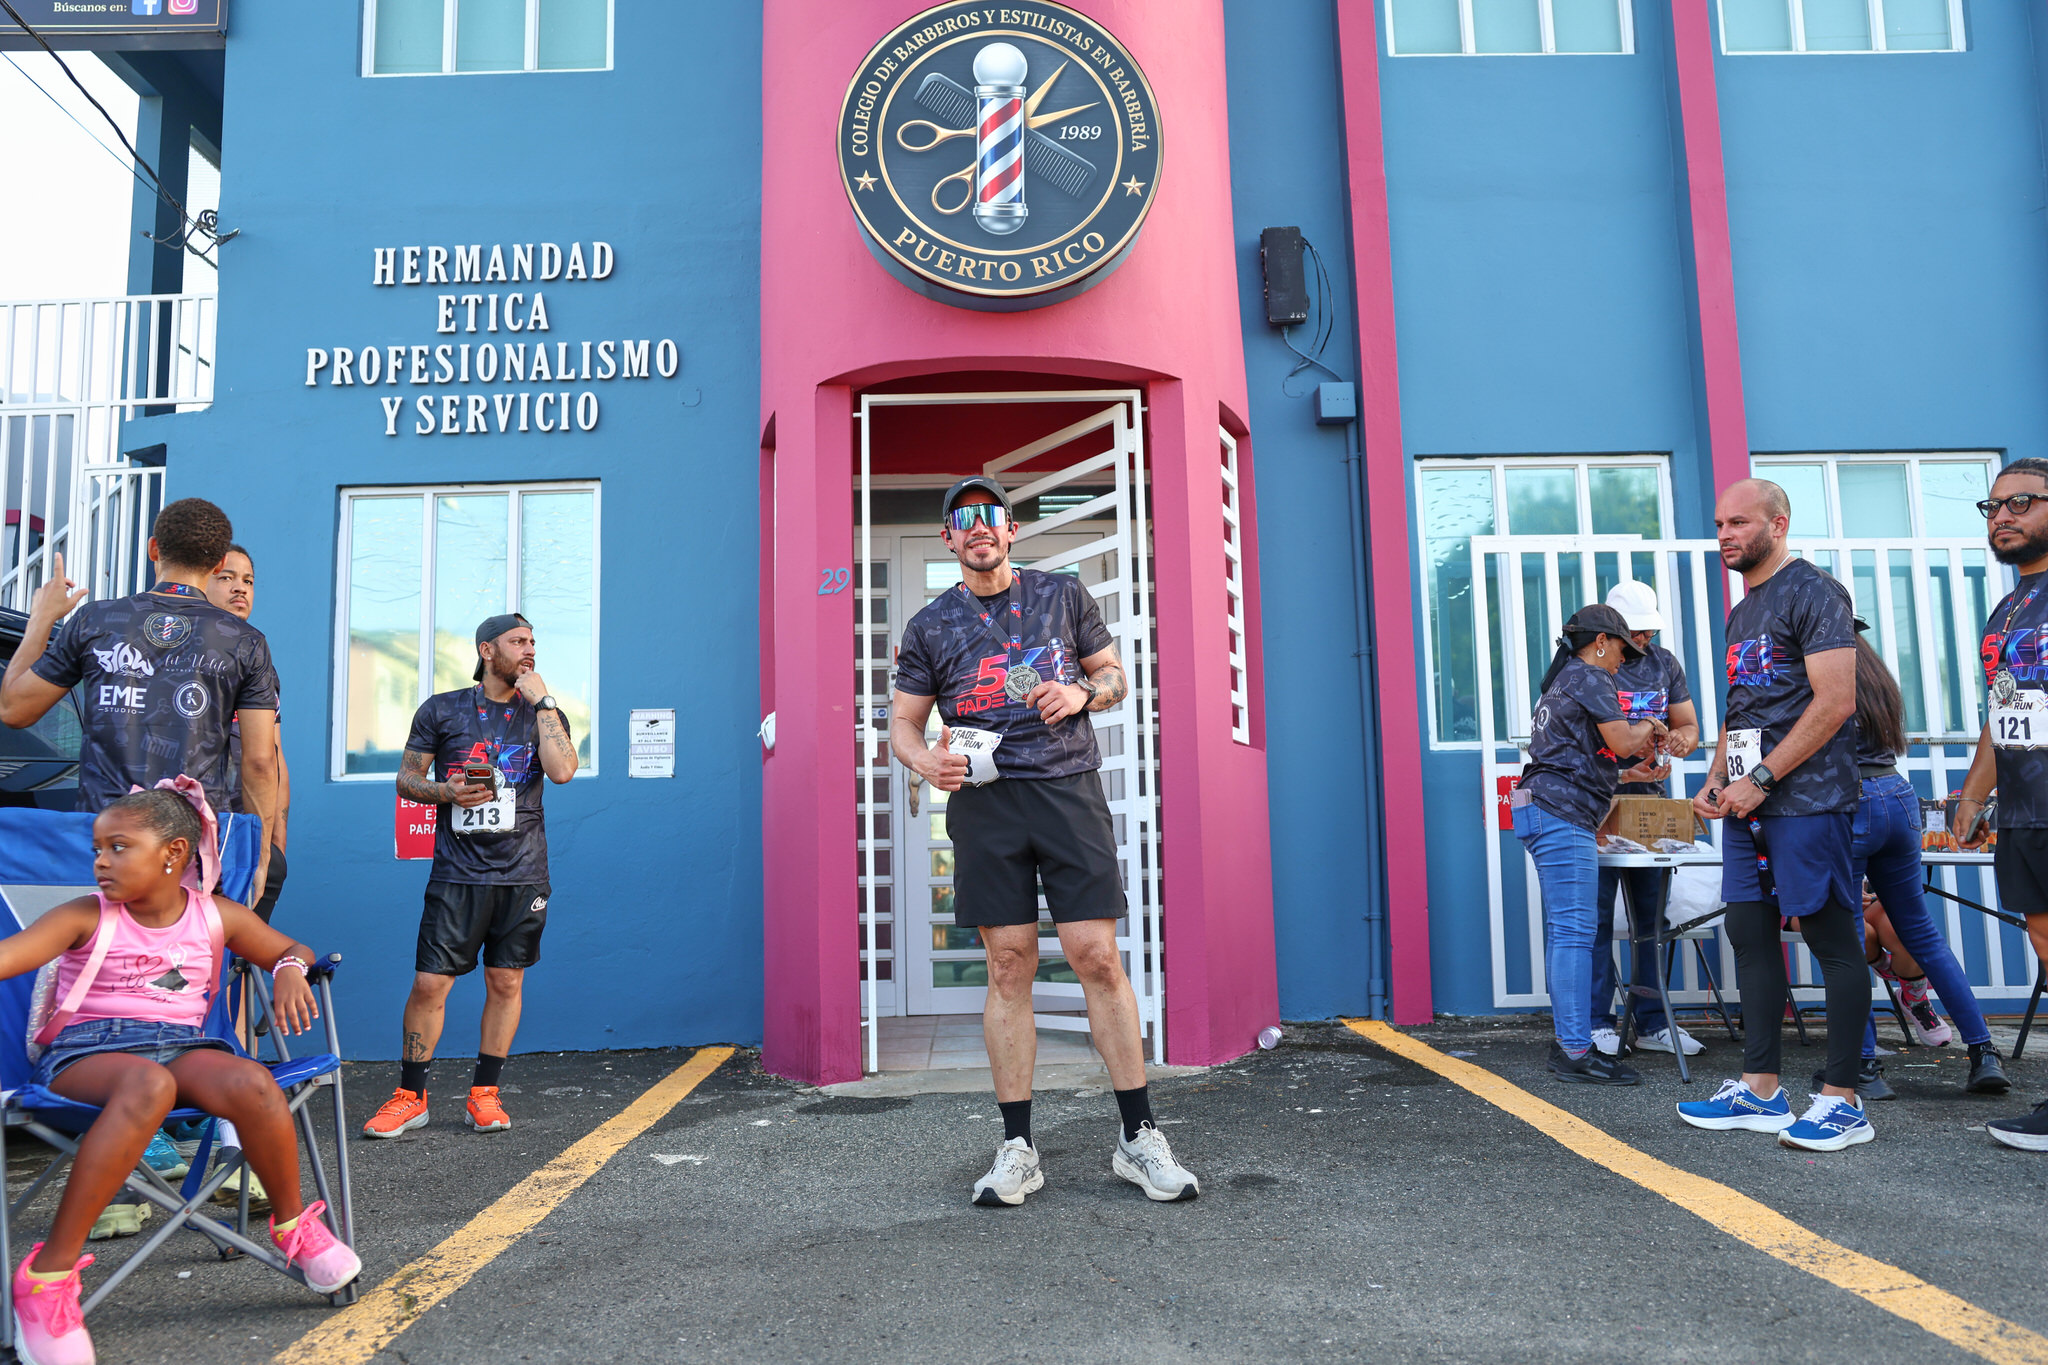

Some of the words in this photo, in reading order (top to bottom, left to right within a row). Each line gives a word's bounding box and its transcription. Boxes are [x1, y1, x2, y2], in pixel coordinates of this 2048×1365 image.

[53, 2, 106, 12] Búscanos
[110, 4, 127, 12] en:
[852, 80, 882, 156] COLEGIO
[874, 57, 898, 81] DE
[893, 11, 981, 61] BARBEROS
[983, 10, 995, 23] Y
[1000, 9, 1094, 51] ESTILISTAS
[1091, 45, 1116, 69] EN
[1109, 67, 1150, 152] BARBERÍA
[1059, 126, 1101, 140] 1989
[373, 241, 614, 285] HERMANDAD
[893, 227, 1021, 281] PUERTO
[1030, 231, 1105, 279] RICO
[437, 292, 549, 333] ETICA
[305, 338, 679, 386] PROFESIONALISMO
[380, 396, 403, 435] Y
[416, 391, 599, 435] SERVICIO
[818, 568, 850, 595] 29
[99, 685, 147, 708] EME
[956, 692, 1006, 717] FADE
[1617, 690, 1659, 712] 5K
[2014, 702, 2033, 710] RUN
[955, 729, 979, 742] FADE
[1998, 716, 2031, 740] 121
[963, 740, 984, 750] RUN
[1734, 742, 1748, 750] RUN
[463, 807, 500, 826] 213
